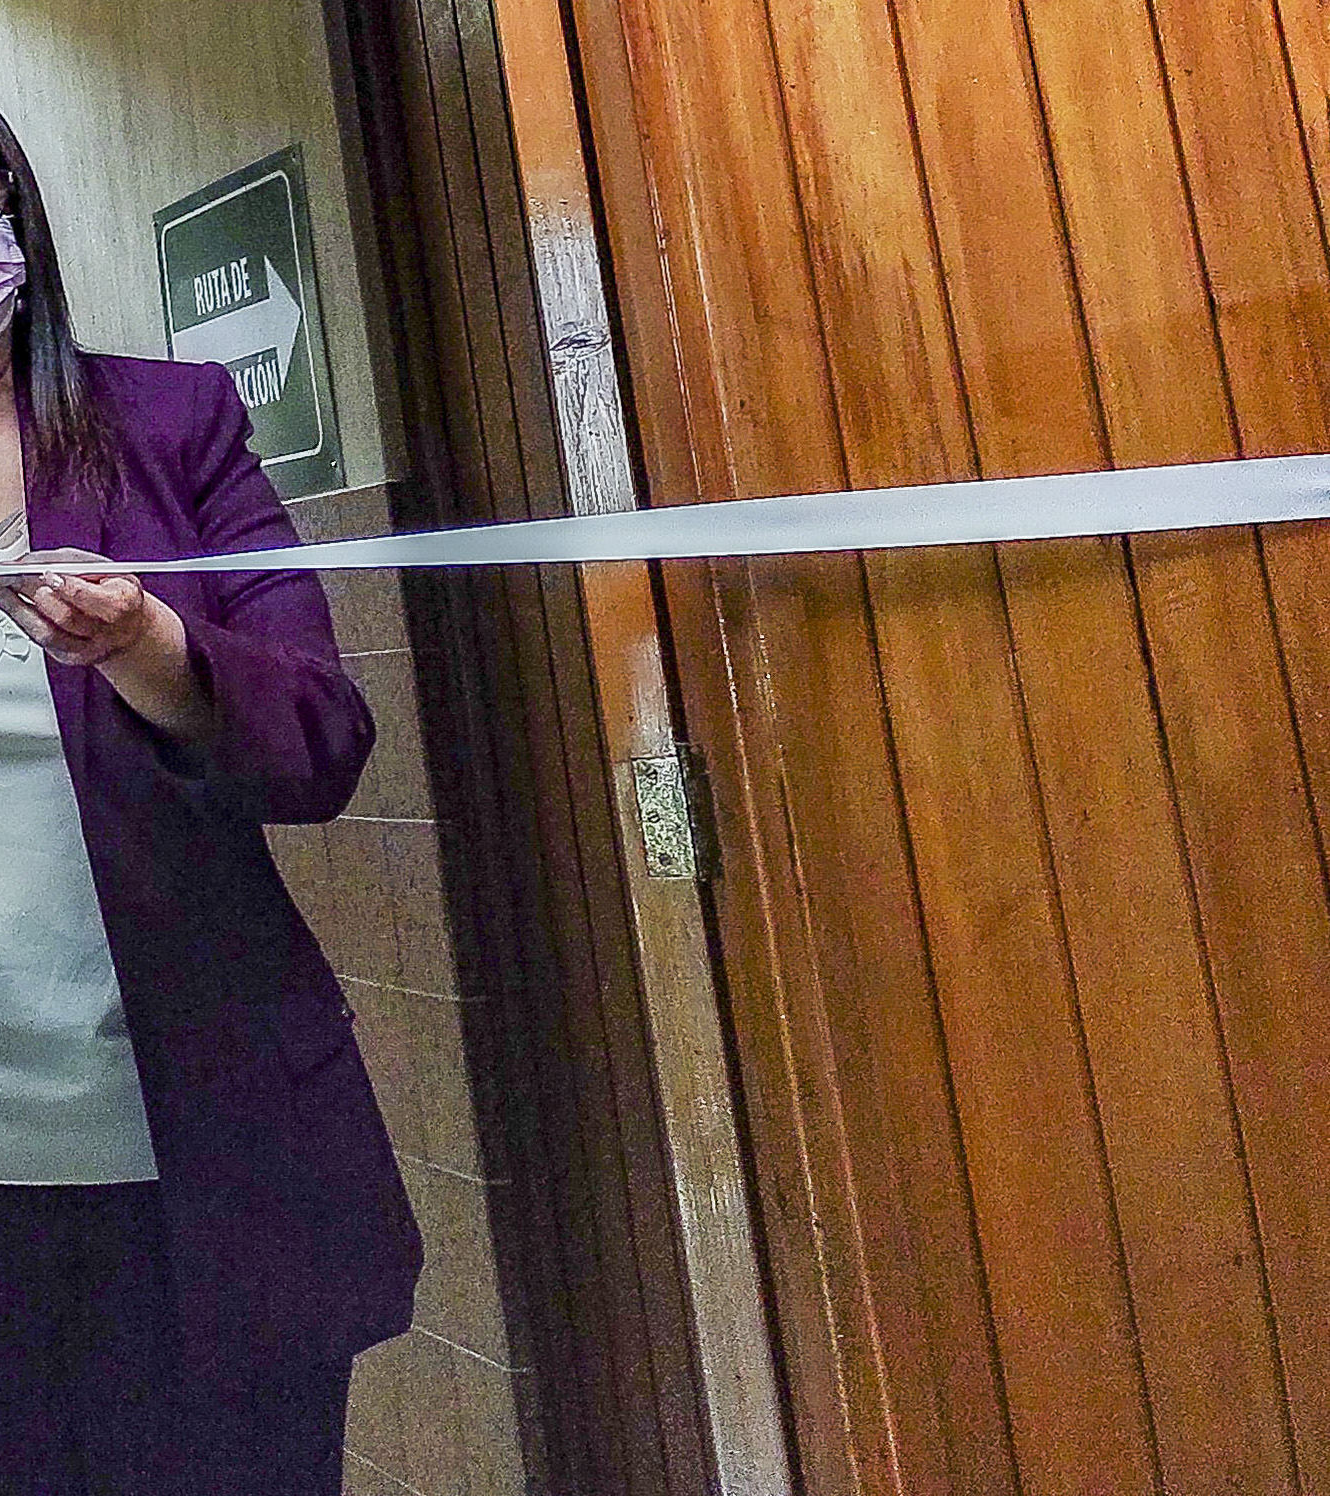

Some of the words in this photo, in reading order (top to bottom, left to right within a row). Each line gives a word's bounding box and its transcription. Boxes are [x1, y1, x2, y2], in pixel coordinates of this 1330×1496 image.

[194, 266, 230, 316] RUTA
[230, 256, 252, 303] DE
[229, 354, 281, 409] ACIÓN
